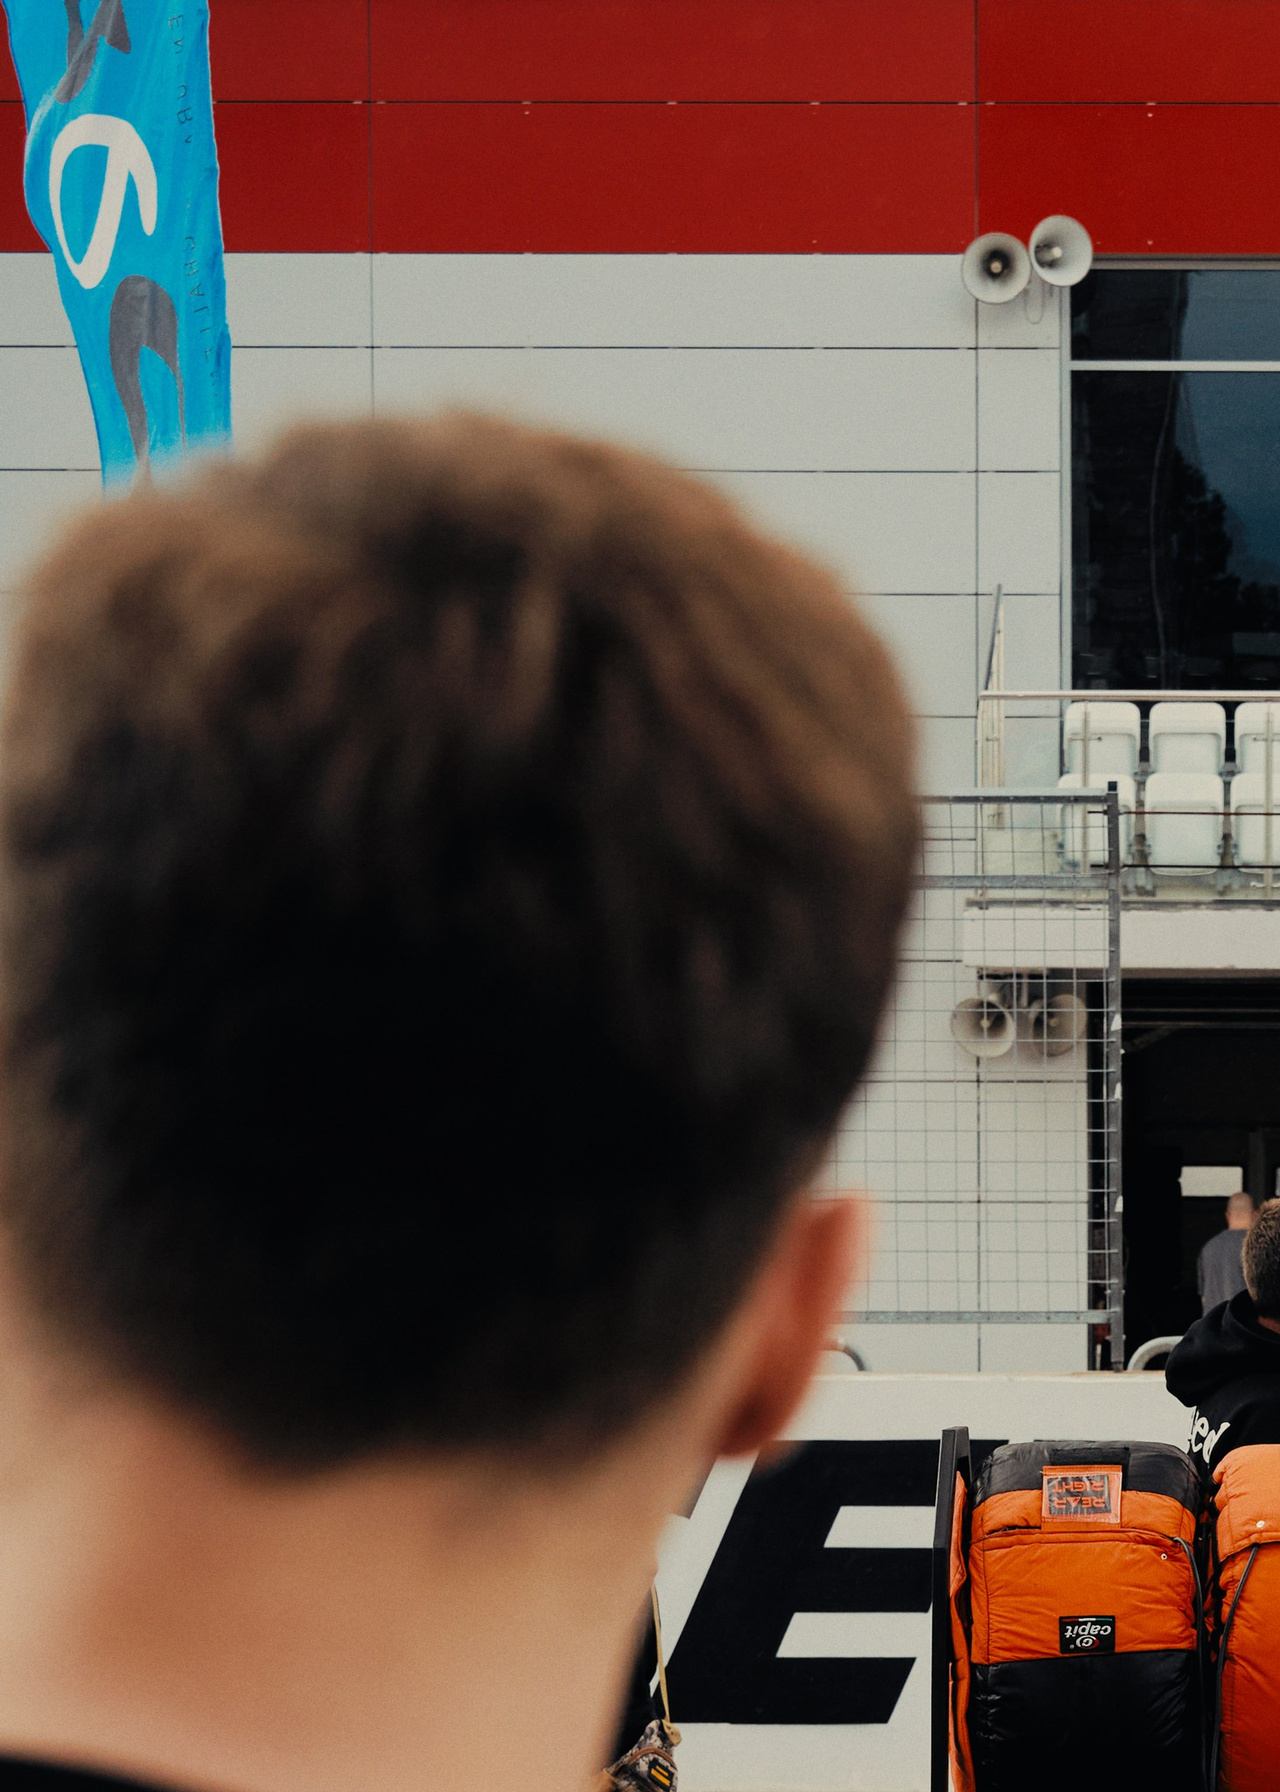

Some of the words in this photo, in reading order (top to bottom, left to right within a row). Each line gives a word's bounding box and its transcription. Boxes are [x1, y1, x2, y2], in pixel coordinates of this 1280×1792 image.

[1051, 1480, 1105, 1493] RIGHT
[1053, 1495, 1106, 1509] REAR
[1064, 1622, 1112, 1638] capit
